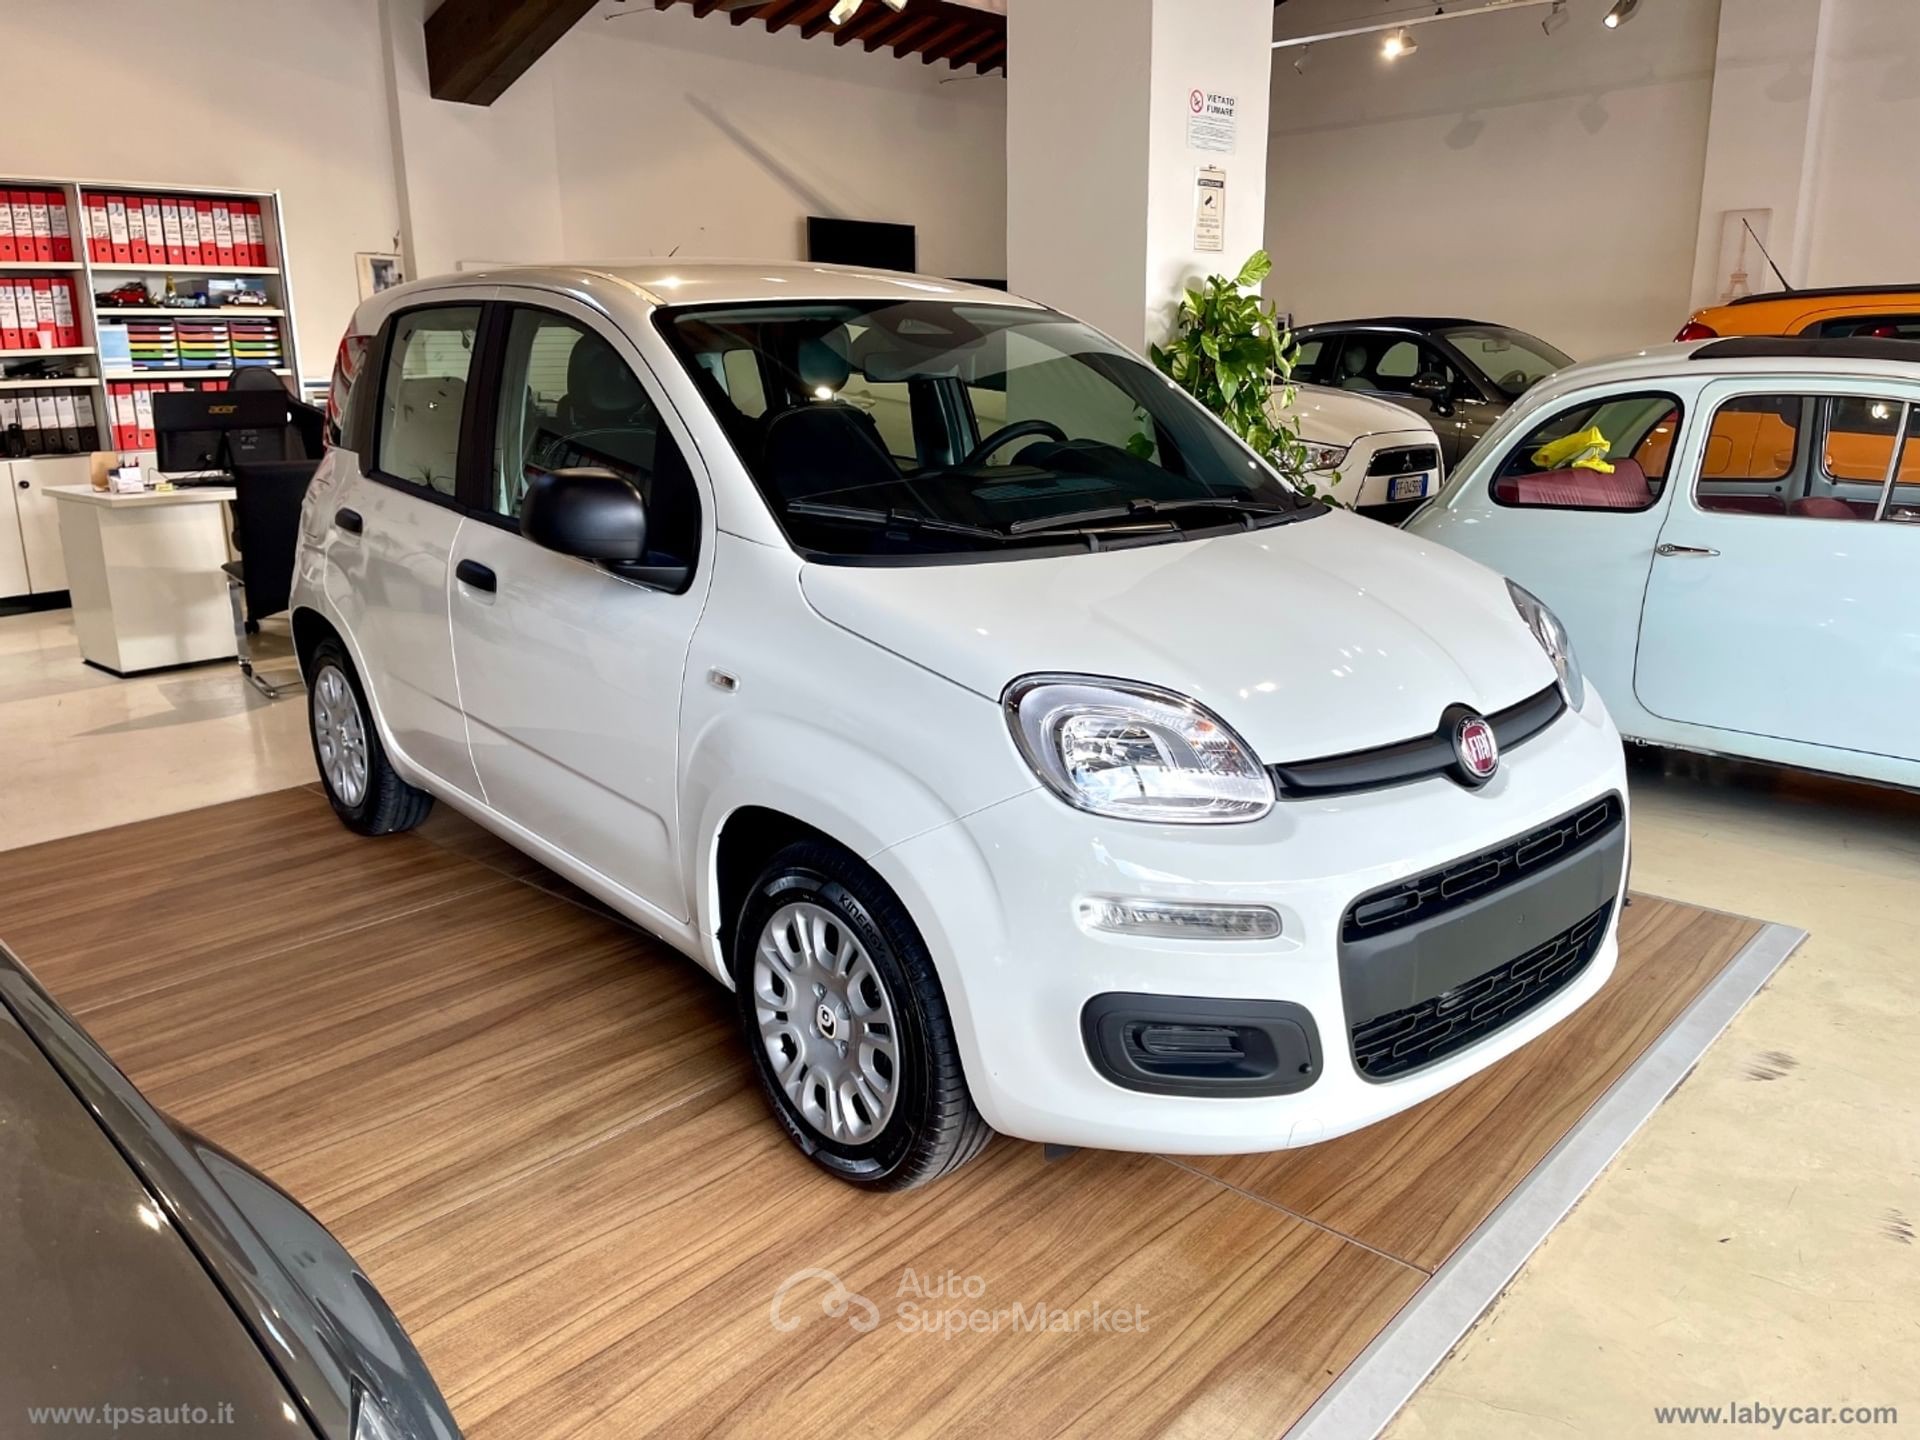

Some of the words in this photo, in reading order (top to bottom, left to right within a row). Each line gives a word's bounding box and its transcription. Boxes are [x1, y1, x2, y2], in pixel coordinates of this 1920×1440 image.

[1206, 93, 1235, 107] VIETATO
[1206, 104, 1235, 117] FUMARE
[208, 404, 238, 415] acer
[1467, 729, 1491, 762] FIAT
[838, 893, 886, 953] KINERGY
